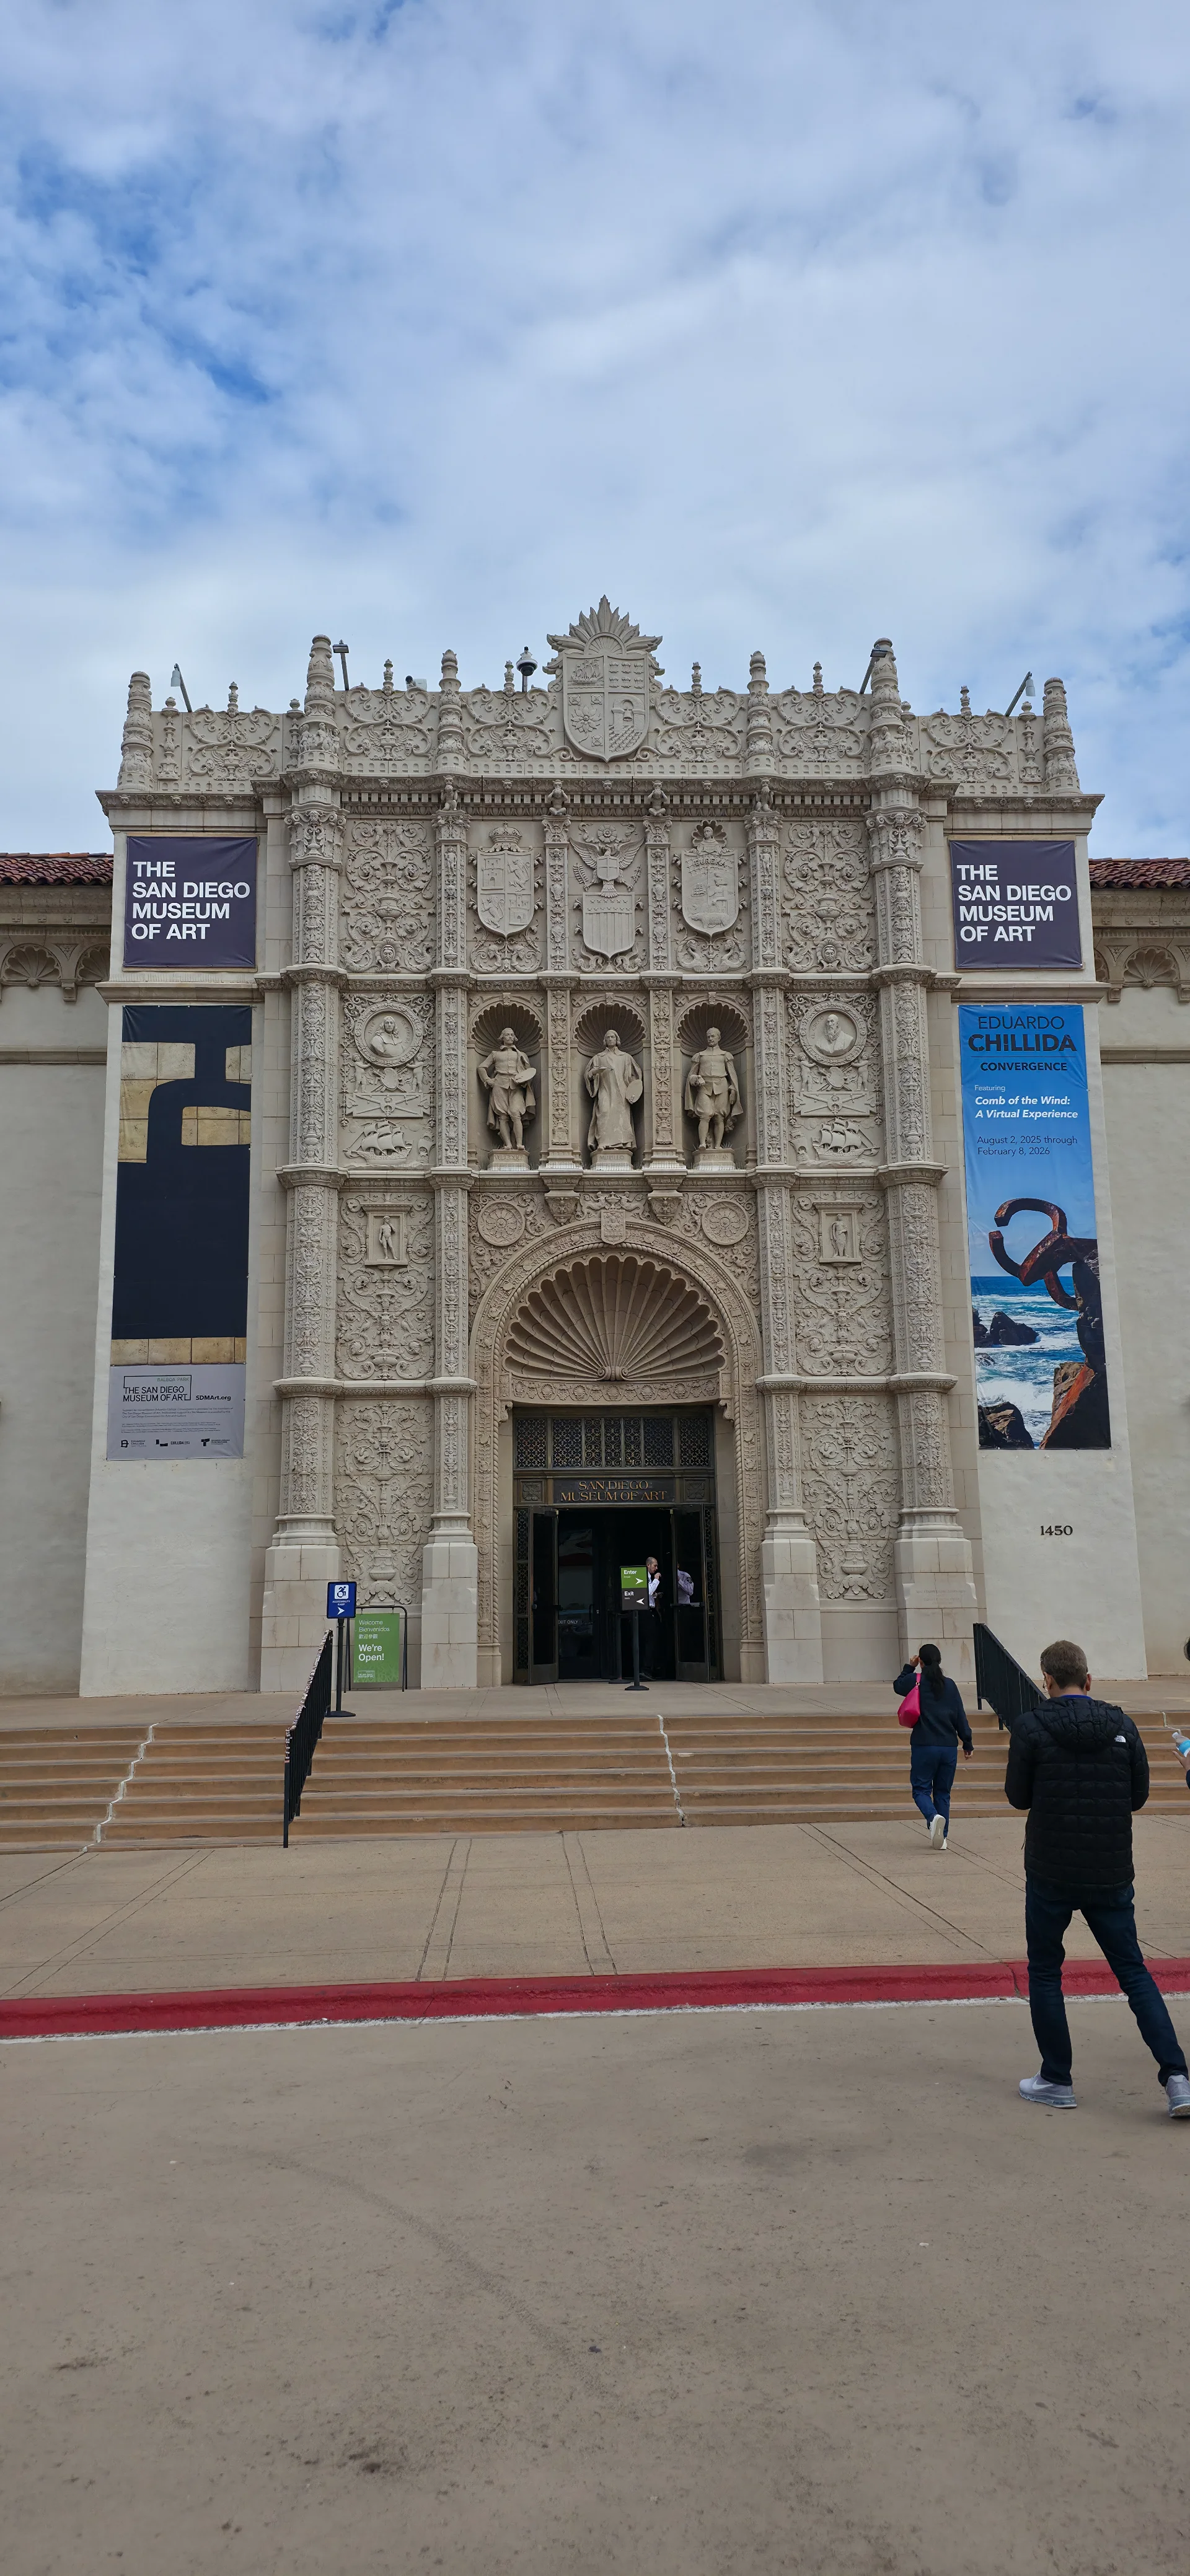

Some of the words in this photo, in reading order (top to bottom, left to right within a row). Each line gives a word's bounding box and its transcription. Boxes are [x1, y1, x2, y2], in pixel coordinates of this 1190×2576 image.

[133, 861, 175, 877] THE
[956, 864, 998, 880] THE
[132, 882, 176, 898] SAN
[183, 882, 250, 898] DIEGO
[958, 885, 1000, 901] SAN
[1007, 885, 1072, 901] DIEGO
[133, 902, 230, 919] MUSEUM
[959, 905, 1054, 921] MUSEUM
[131, 923, 161, 939] OF
[165, 923, 210, 939] ART
[960, 926, 989, 942] OF
[994, 926, 1036, 941] ART
[978, 1016, 1065, 1030] EDUARDO
[968, 1034, 1077, 1052] CHILLIDA
[980, 1062, 1067, 1071] CONVERGENCE
[975, 1096, 1006, 1105] Comb
[1008, 1096, 1020, 1105] of
[1021, 1096, 1038, 1104] the
[1041, 1096, 1070, 1104] Wind:
[975, 1110, 984, 1118] A
[986, 1110, 1020, 1118] Virtual
[1022, 1109, 1078, 1120] Experience
[977, 1135, 1008, 1145] August
[1010, 1135, 1018, 1145] 2,
[1020, 1135, 1041, 1143] 2025
[1044, 1135, 1078, 1145] through
[977, 1147, 1016, 1156] February
[1018, 1147, 1026, 1156] 8,
[1029, 1147, 1050, 1155] 2026
[160, 1386, 185, 1394] DIEGO
[123, 1394, 159, 1402] MUSEUM
[578, 1480, 605, 1490] SAN
[608, 1480, 649, 1490] DIEGO
[560, 1492, 618, 1501] MUSEUM
[620, 1492, 639, 1501] OF
[641, 1491, 667, 1500] ART
[1040, 1525, 1073, 1536] 1450
[358, 1653, 384, 1663] Open!
